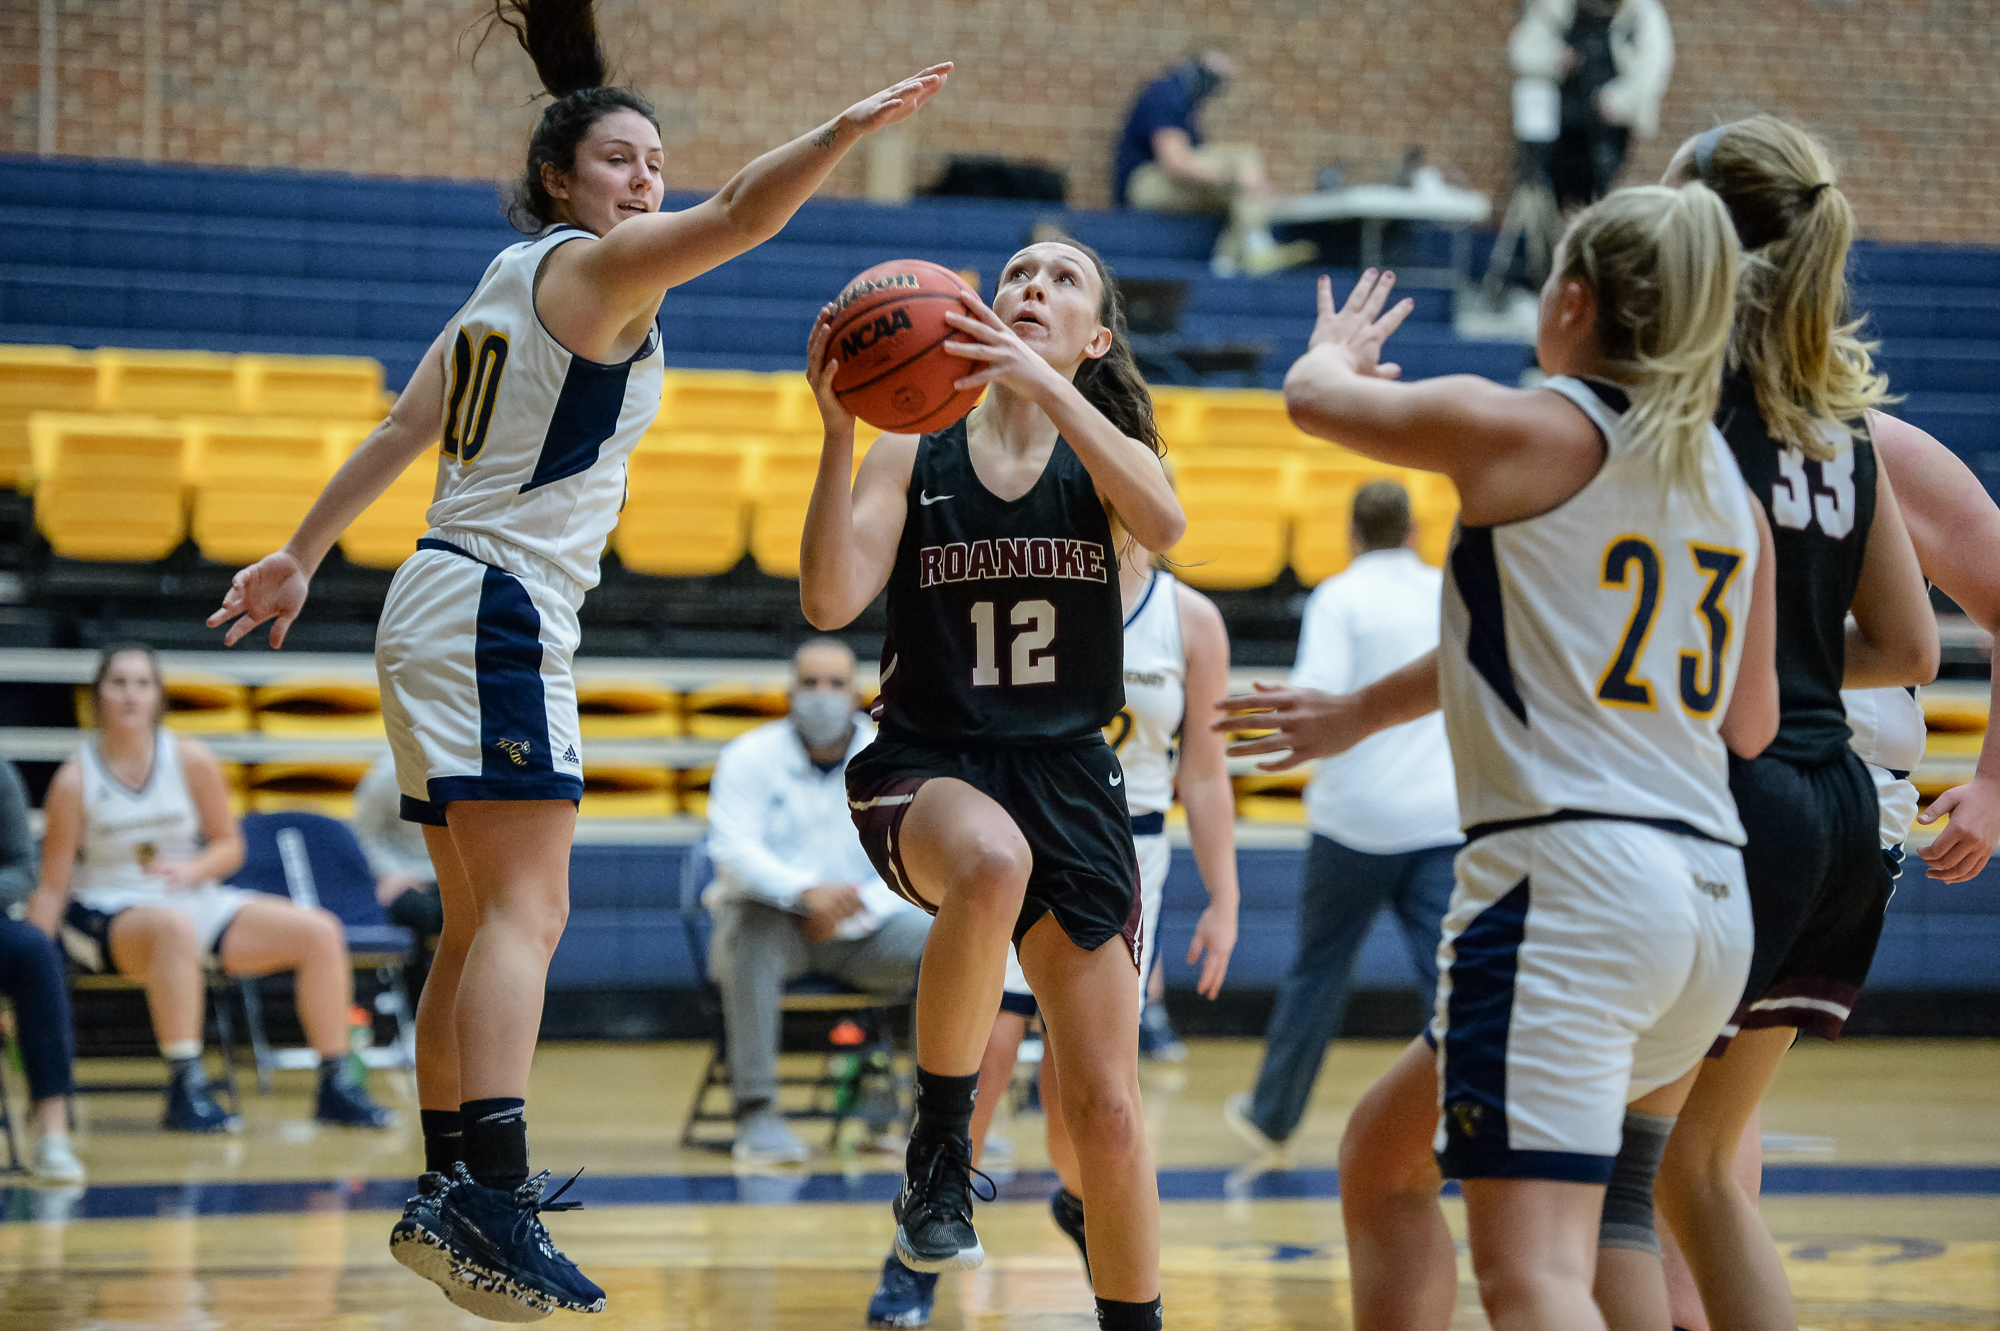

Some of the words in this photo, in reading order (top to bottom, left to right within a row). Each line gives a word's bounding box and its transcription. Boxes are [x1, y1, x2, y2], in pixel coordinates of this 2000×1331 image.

[841, 308, 913, 362] NCAA
[1772, 420, 1856, 540] 33
[920, 537, 1107, 588] ROANOKE
[970, 599, 1057, 687] 12
[1595, 532, 1747, 720] 23
